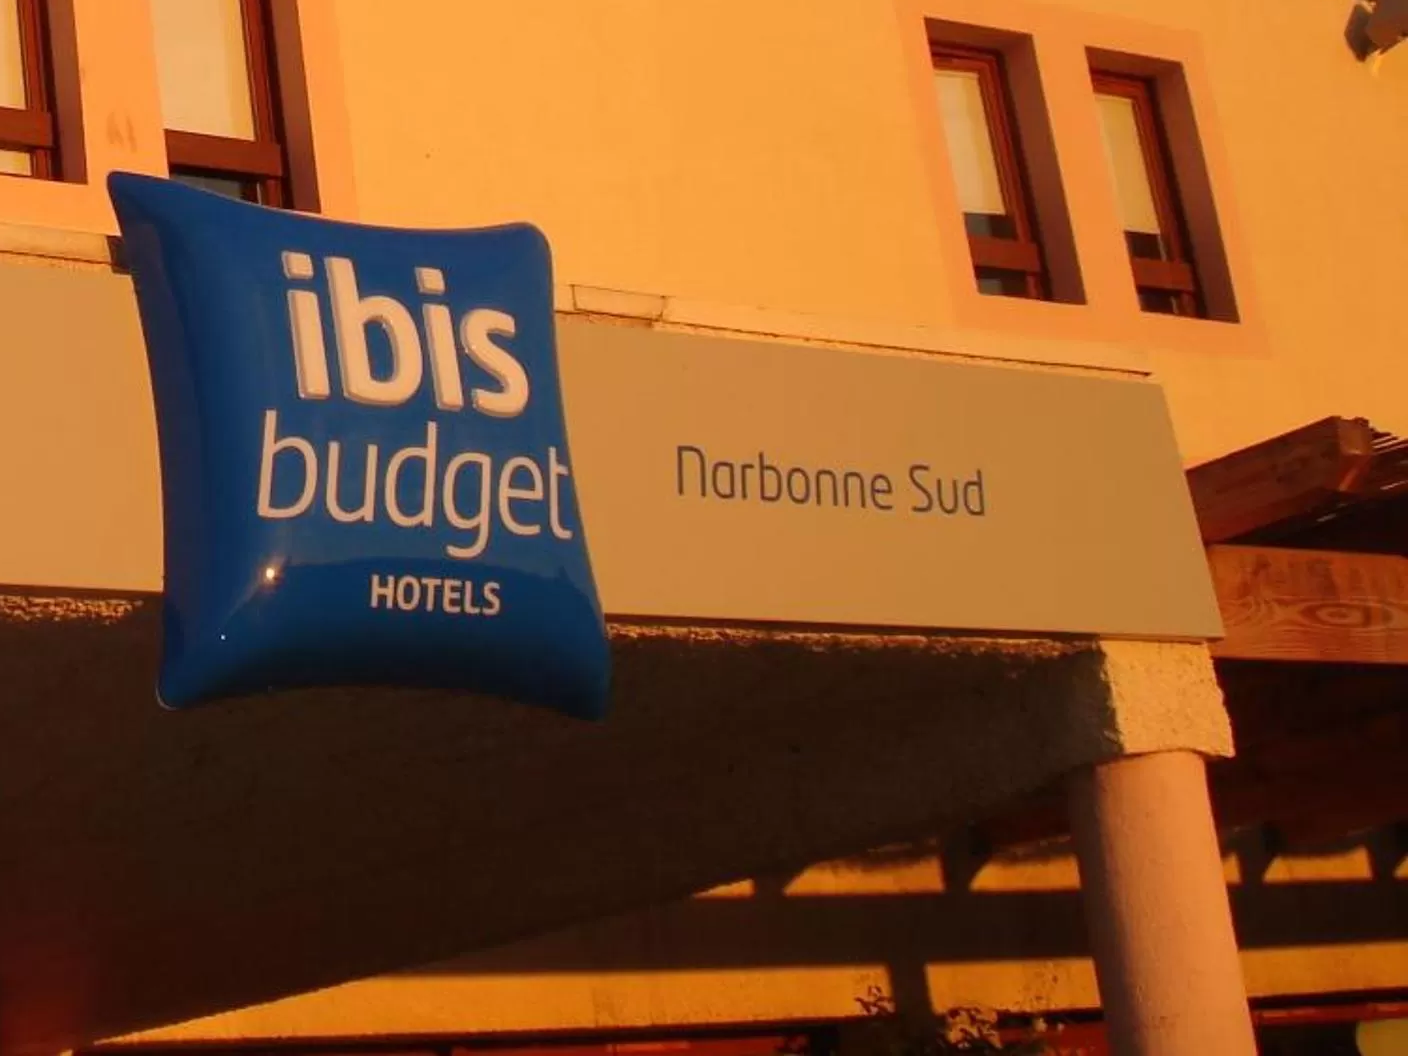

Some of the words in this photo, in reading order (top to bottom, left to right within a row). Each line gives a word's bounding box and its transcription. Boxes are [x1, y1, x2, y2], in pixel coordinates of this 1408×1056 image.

[281, 250, 530, 419] ibis
[256, 408, 574, 559] budget
[676, 444, 894, 511] Narbonne
[908, 464, 986, 517] Sud
[369, 573, 501, 616] HOTELS
